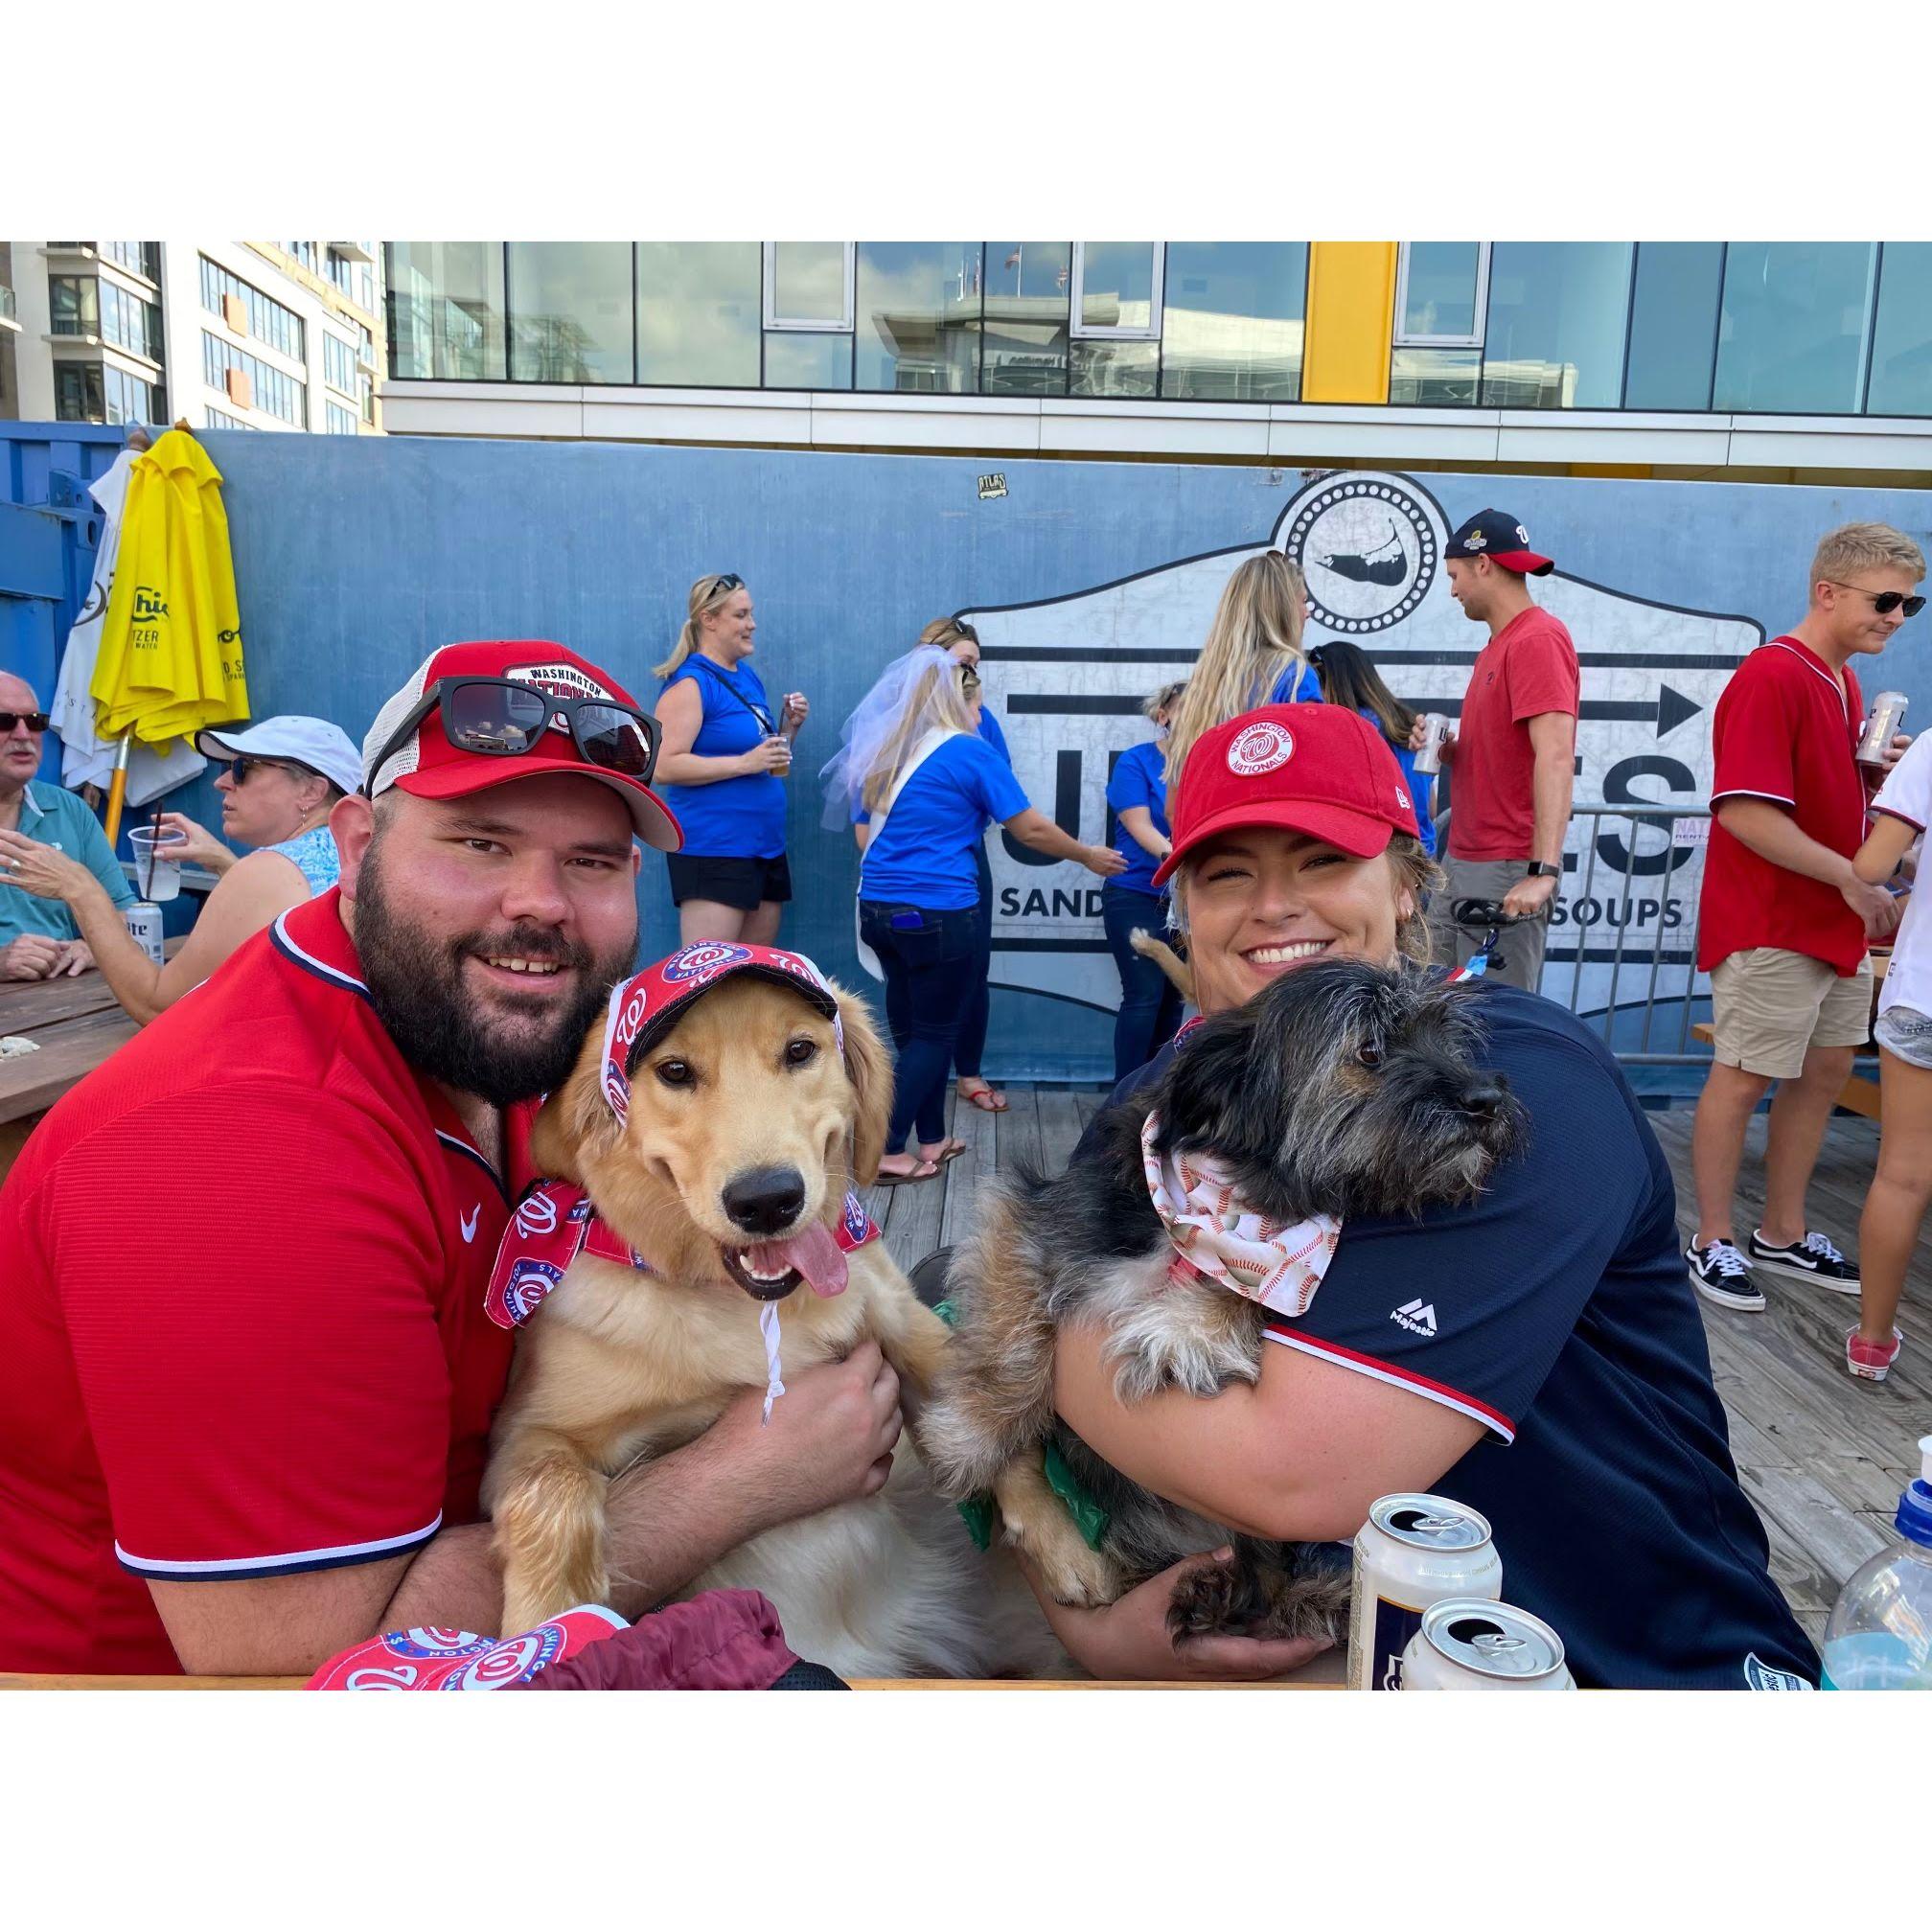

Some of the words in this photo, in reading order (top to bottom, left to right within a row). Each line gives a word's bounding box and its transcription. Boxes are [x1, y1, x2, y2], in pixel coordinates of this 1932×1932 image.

[978, 473, 1006, 491] ATLAS
[530, 668, 602, 698] WASHINGTON
[1230, 724, 1291, 753] WASHINGTON
[1231, 752, 1288, 773] NATIONALS
[1548, 897, 1683, 929] SOUPS
[126, 922, 148, 936] ite
